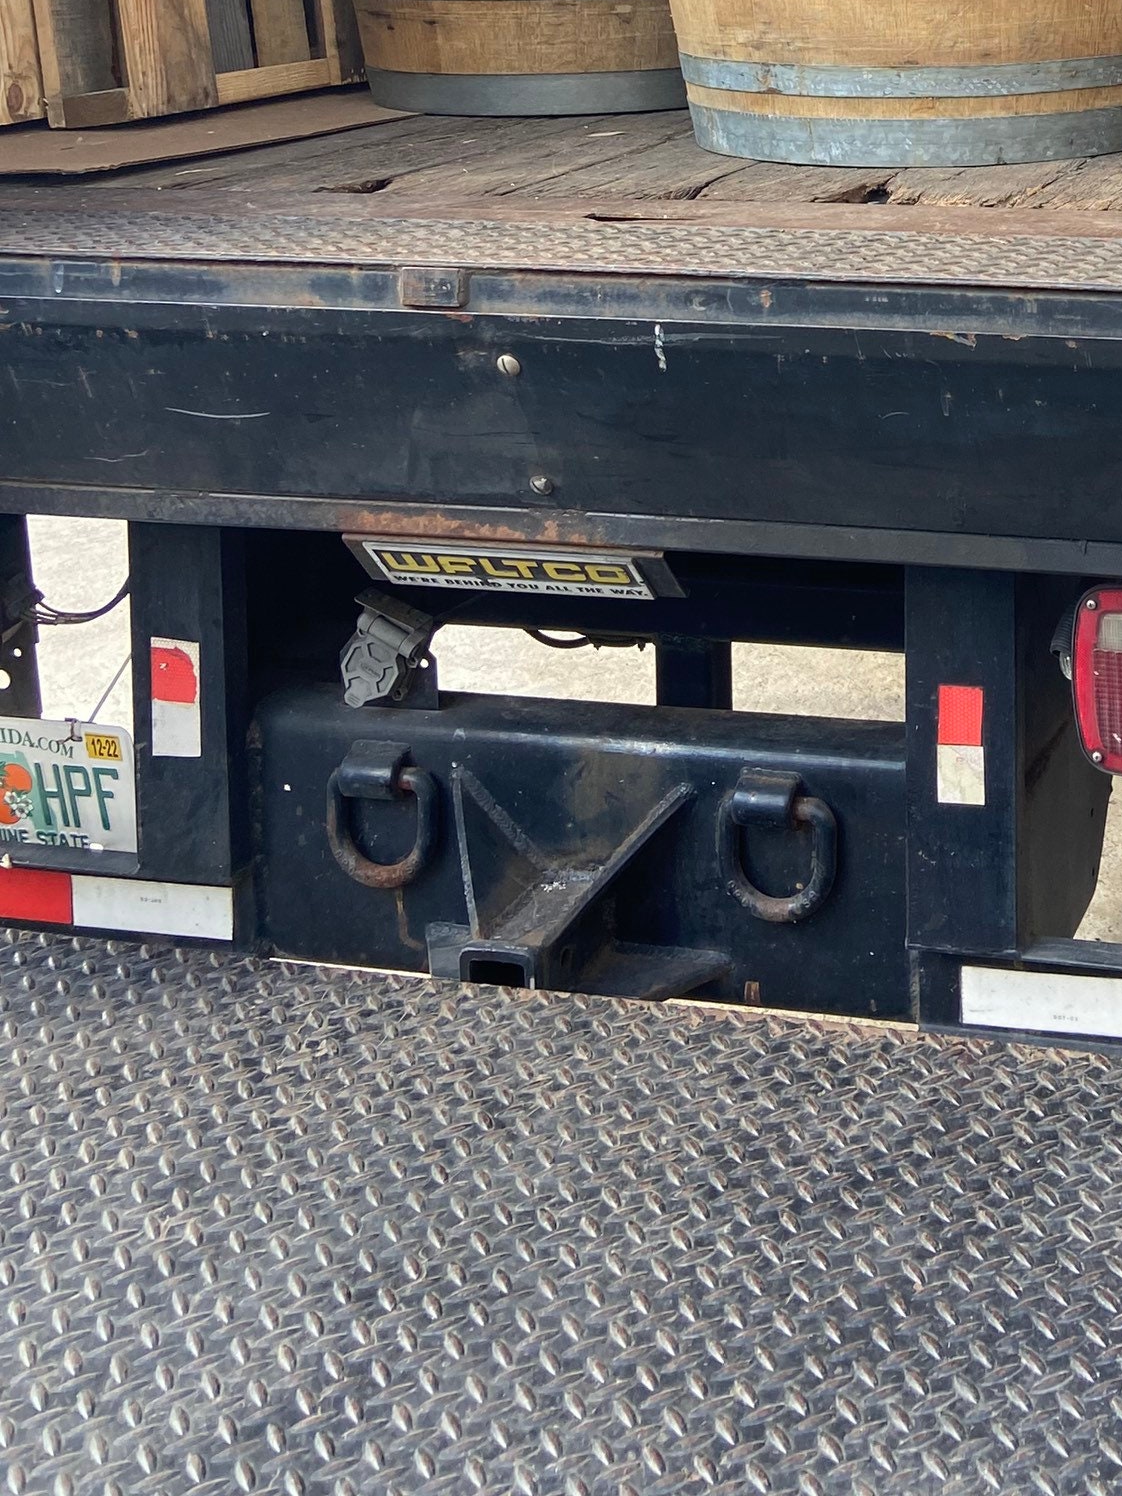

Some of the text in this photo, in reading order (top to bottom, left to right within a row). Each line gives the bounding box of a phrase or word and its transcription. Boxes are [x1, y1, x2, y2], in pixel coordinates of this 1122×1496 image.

[394, 574, 442, 585] WE'RE
[445, 577, 503, 588] BEHIND
[506, 582, 540, 591] YOU
[545, 584, 573, 593] ALL
[576, 586, 605, 595] THE
[91, 738, 119, 758] 12-22
[34, 762, 119, 831] HPF
[36, 830, 90, 849] STATE
